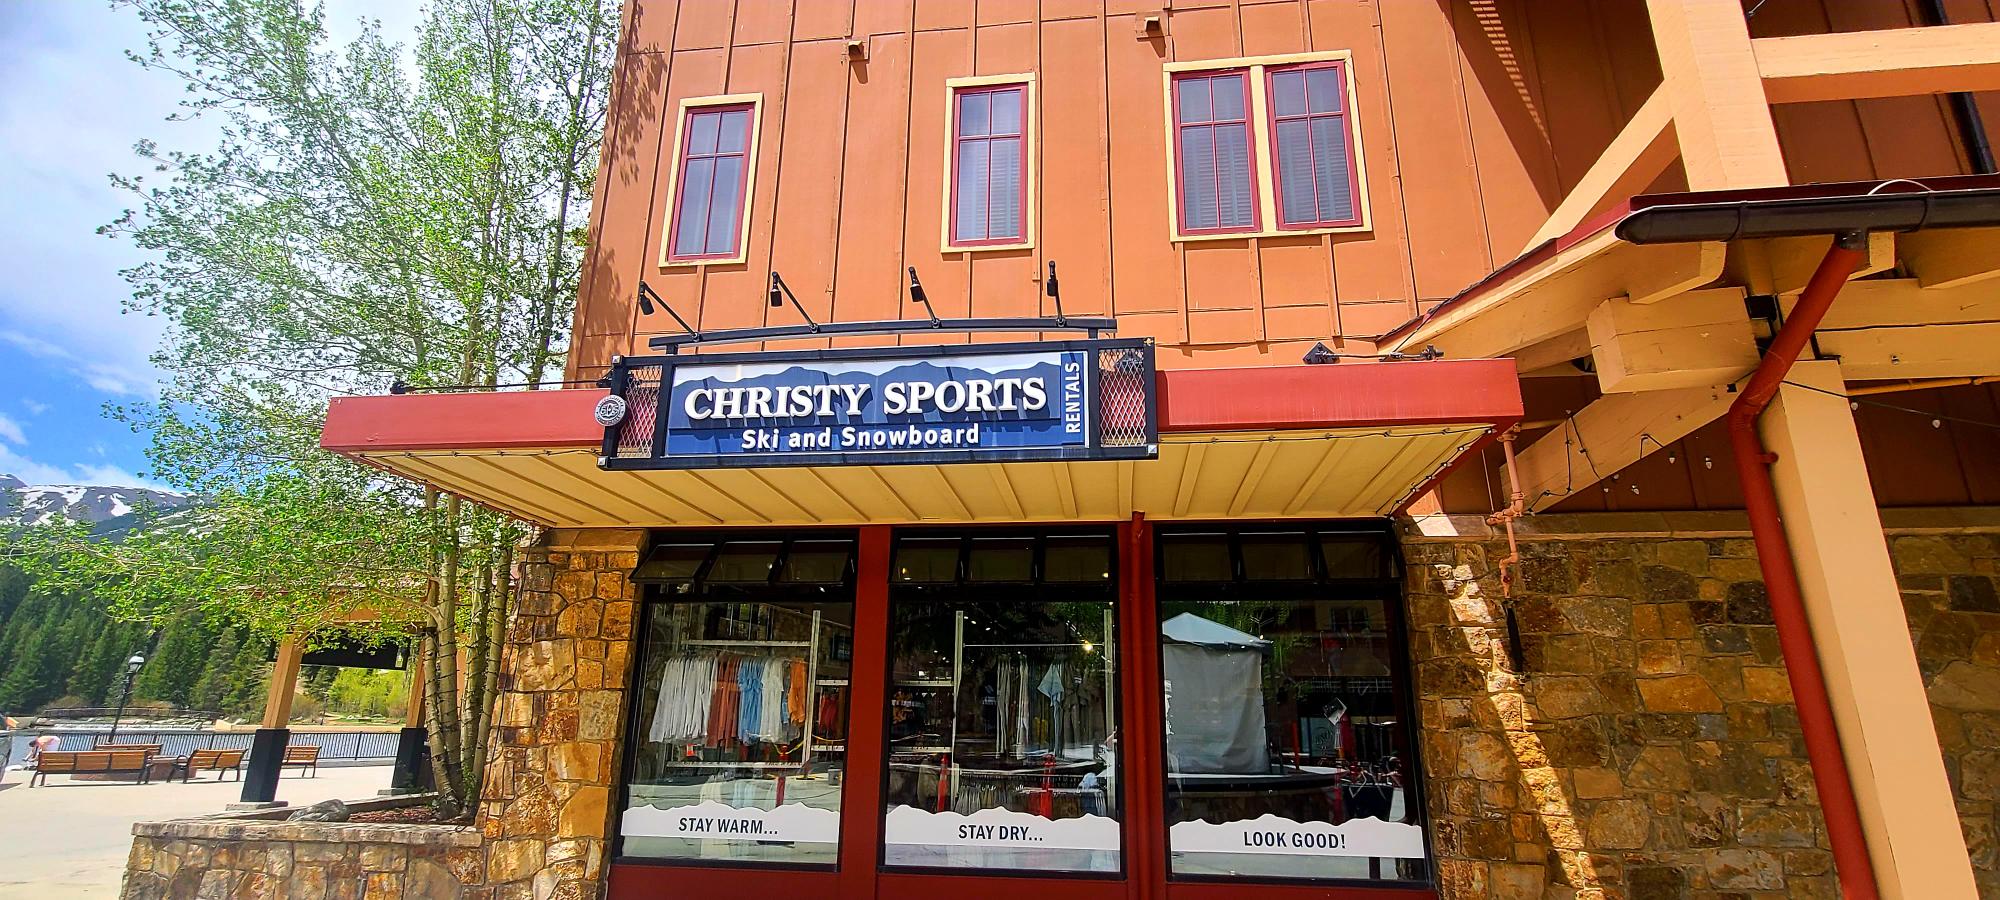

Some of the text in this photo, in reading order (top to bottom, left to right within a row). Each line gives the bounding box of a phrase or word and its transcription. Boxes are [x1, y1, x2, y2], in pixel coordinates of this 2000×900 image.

[685, 377, 1047, 420] CHRISTY SPORTS
[1065, 362, 1080, 433] RENTALS
[742, 423, 979, 449] Ski and Snowboard
[678, 817, 778, 835] STAY WARM...
[958, 824, 1043, 842] STAY DRY...
[1243, 831, 1346, 849] LOOK GOOD!
